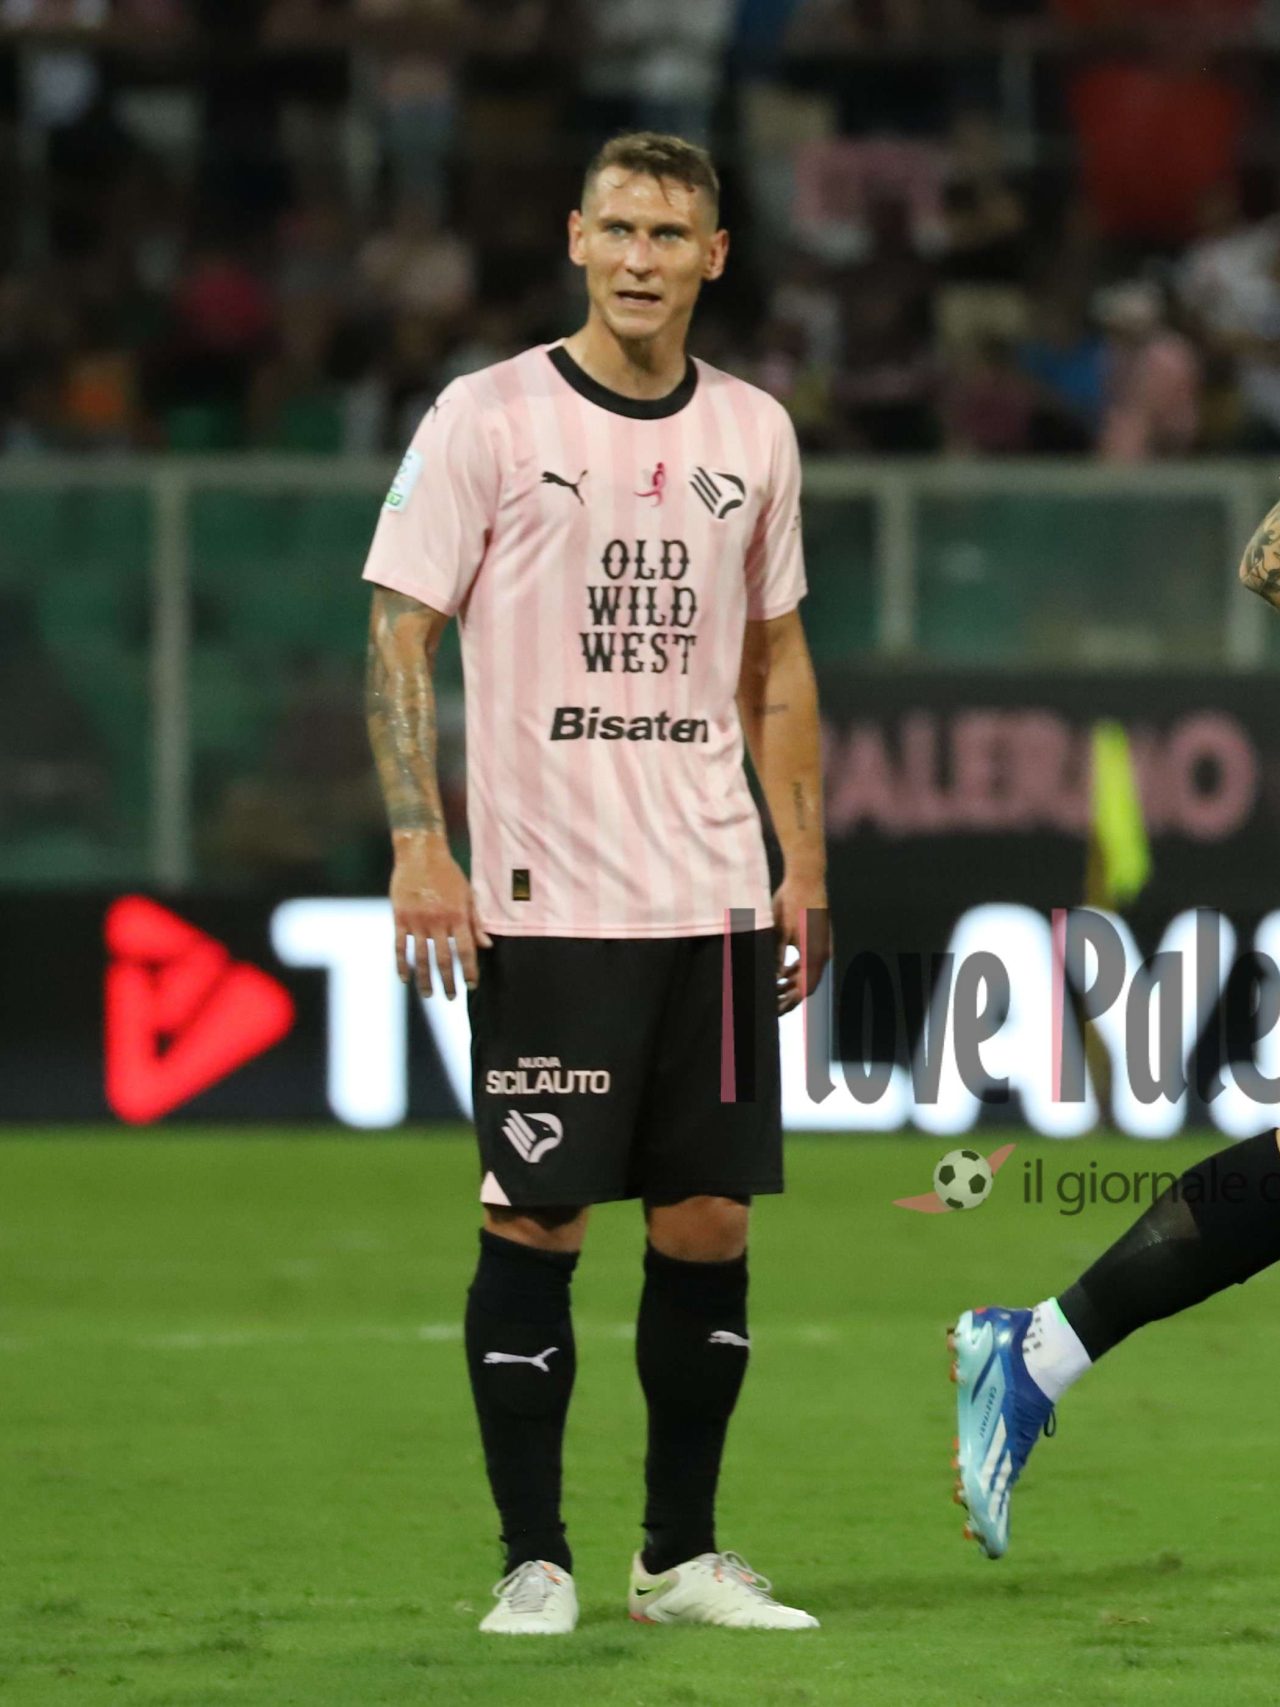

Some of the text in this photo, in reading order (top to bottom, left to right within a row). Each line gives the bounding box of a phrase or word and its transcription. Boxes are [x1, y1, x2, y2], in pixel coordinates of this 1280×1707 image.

[600, 539, 690, 581] OLD
[586, 585, 698, 628] WILD
[578, 631, 698, 675] WEST
[550, 706, 709, 744] Bisaten
[518, 1056, 562, 1069] NUOVA
